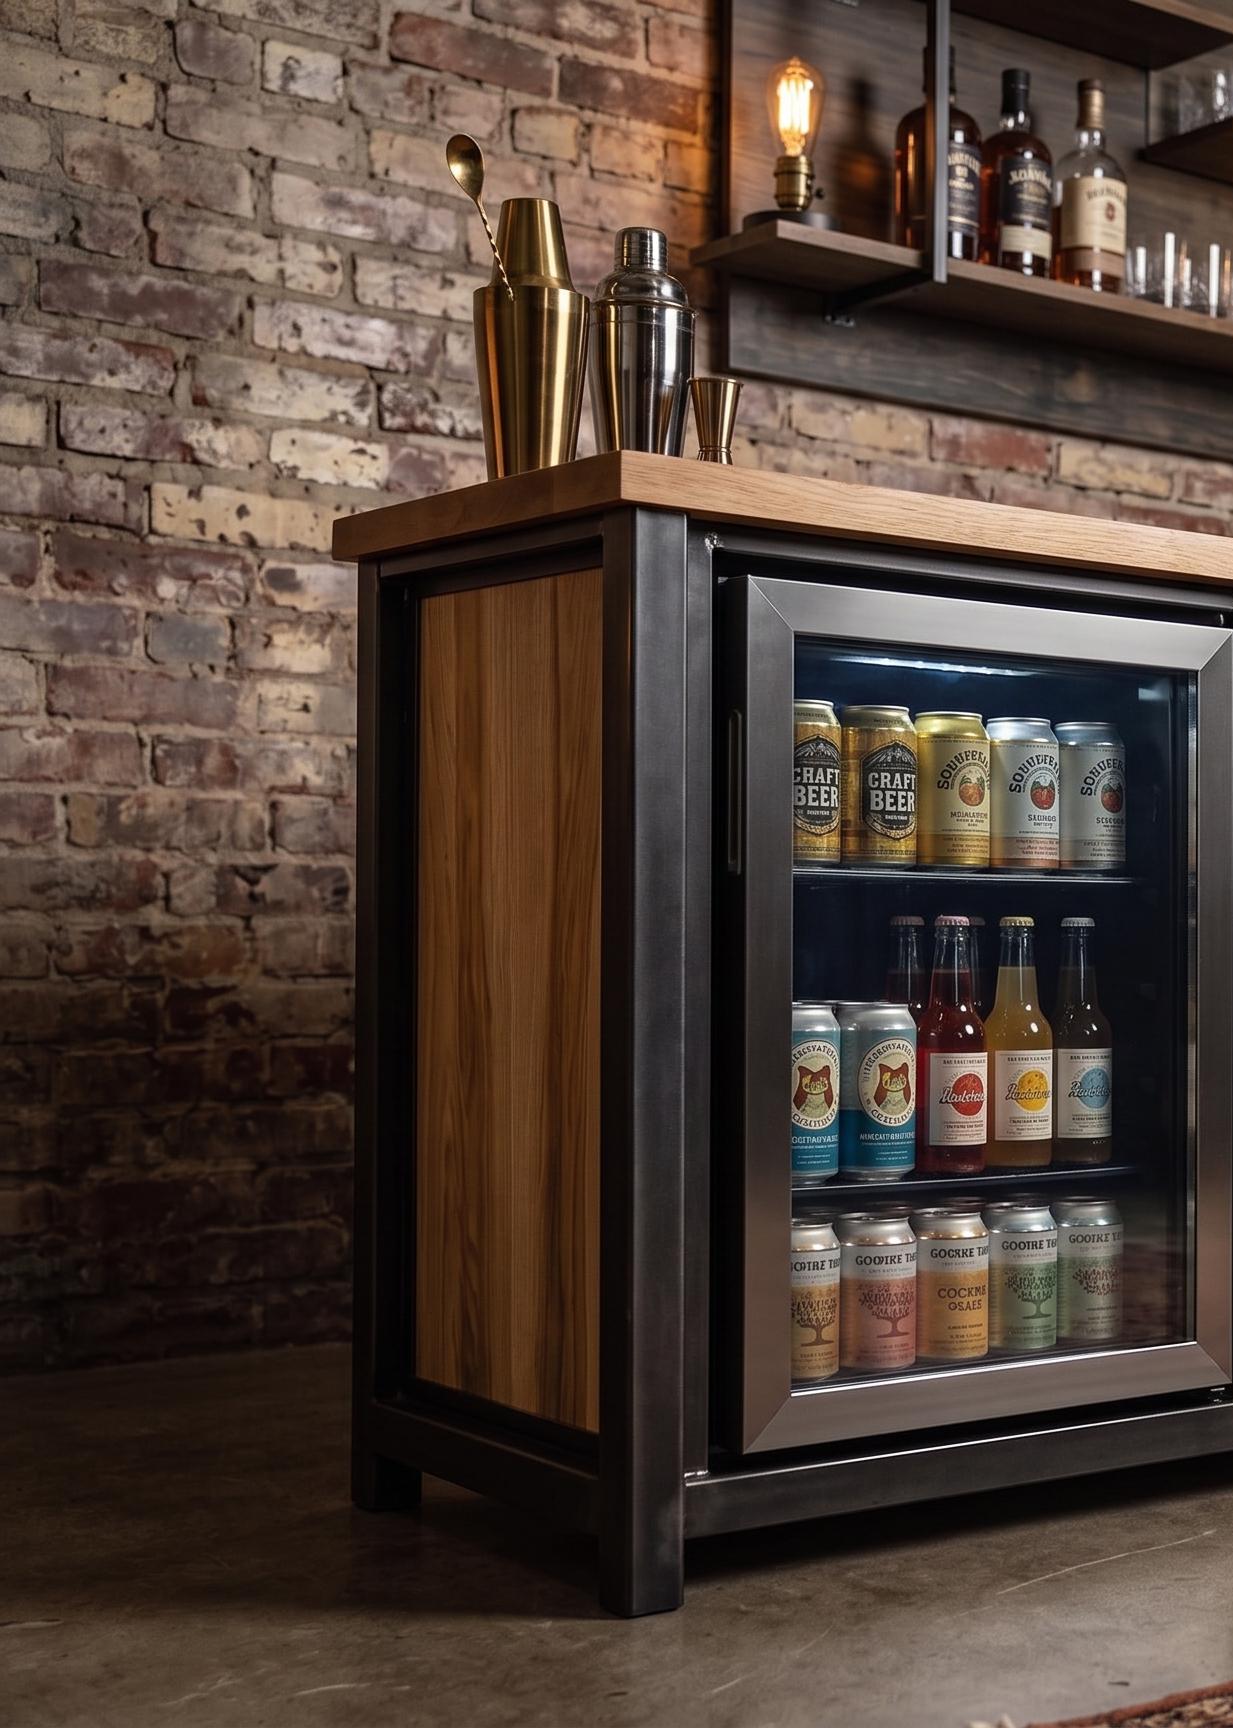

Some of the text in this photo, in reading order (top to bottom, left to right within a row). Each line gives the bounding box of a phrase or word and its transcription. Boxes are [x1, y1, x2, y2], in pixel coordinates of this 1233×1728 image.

[868, 772, 916, 790] CRAFT
[794, 785, 839, 808] BEER
[870, 790, 915, 812] BEER
